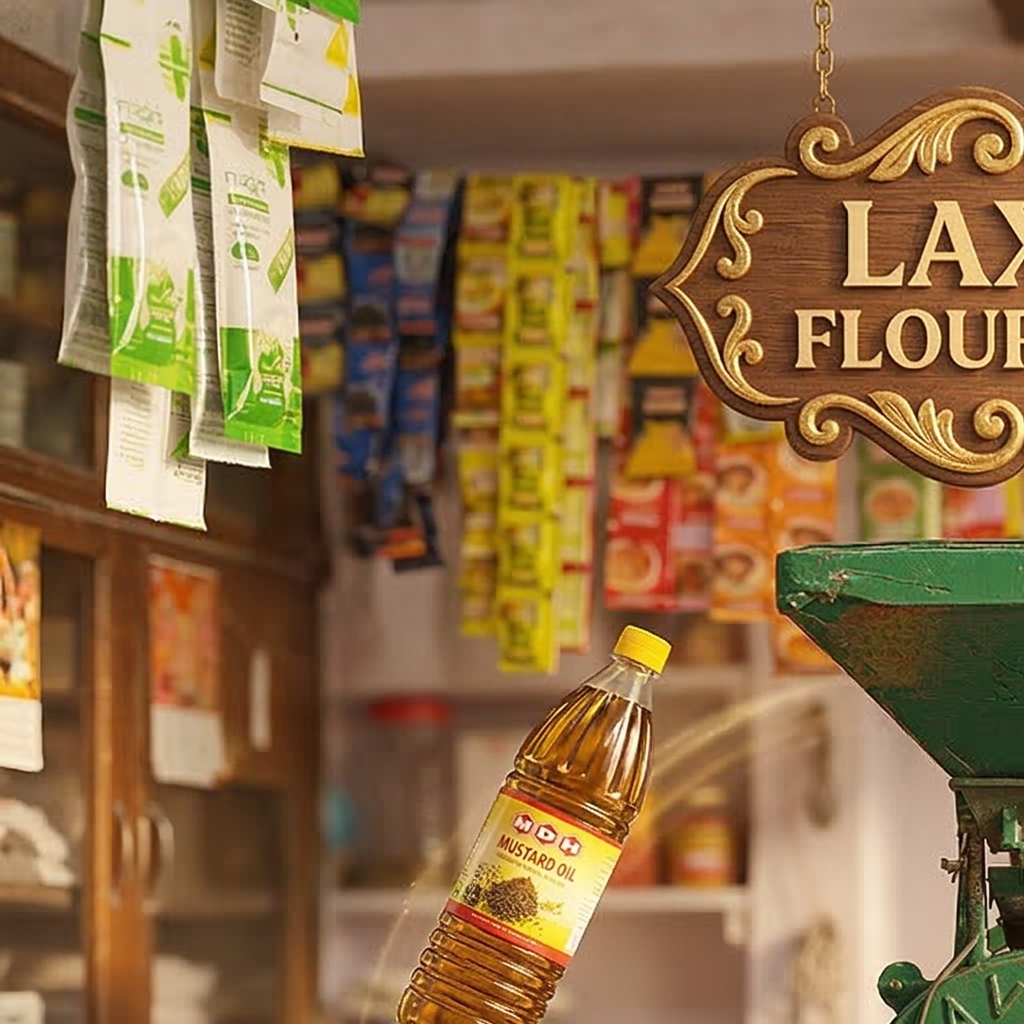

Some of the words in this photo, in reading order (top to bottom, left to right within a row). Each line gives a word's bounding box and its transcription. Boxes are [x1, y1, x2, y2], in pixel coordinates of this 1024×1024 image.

[512, 812, 582, 857] MDH
[496, 834, 556, 871] MUSTARD
[557, 863, 577, 883] OIL
